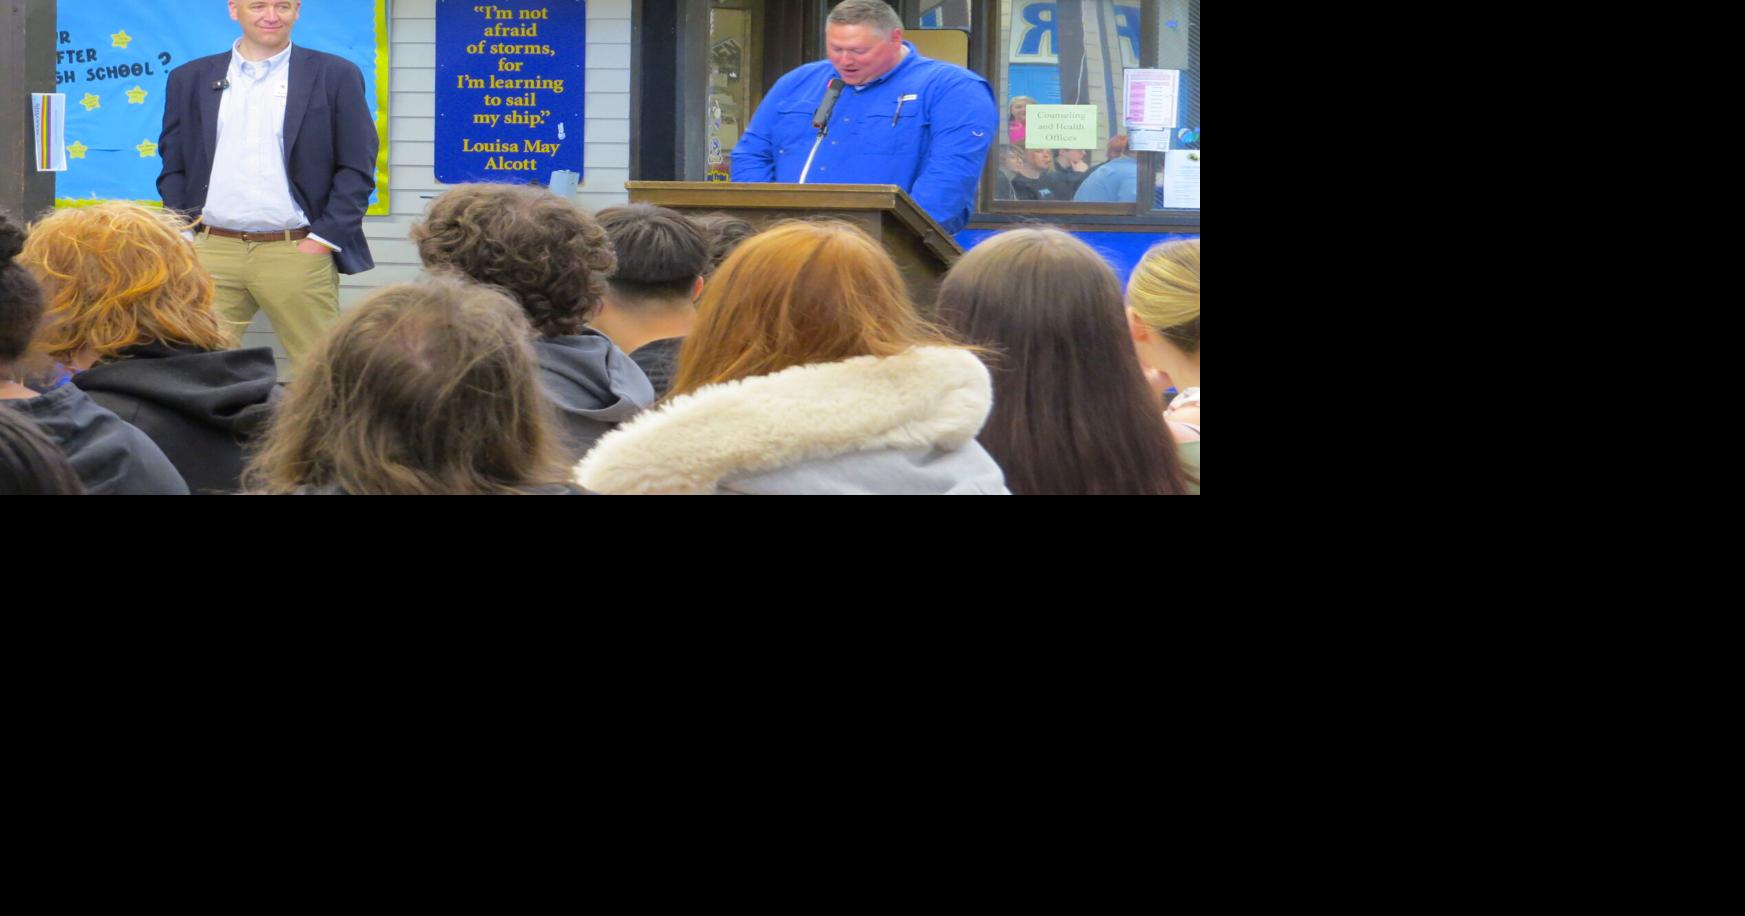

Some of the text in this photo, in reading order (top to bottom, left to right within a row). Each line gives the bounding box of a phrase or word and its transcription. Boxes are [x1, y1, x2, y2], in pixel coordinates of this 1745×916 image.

[474, 5, 548, 19] “I’m not
[484, 22, 538, 37] afraid
[56, 31, 70, 44] R
[466, 40, 556, 56] of storms,
[498, 57, 523, 71] for
[457, 74, 564, 93] I’m learning
[484, 92, 536, 106] to sail
[473, 110, 551, 128] my ship.”
[1037, 111, 1087, 121] Counseling
[1056, 122, 1085, 130] Health
[1045, 133, 1078, 141] Offices
[462, 138, 560, 157] Louisa May
[484, 156, 537, 170] Alcott
